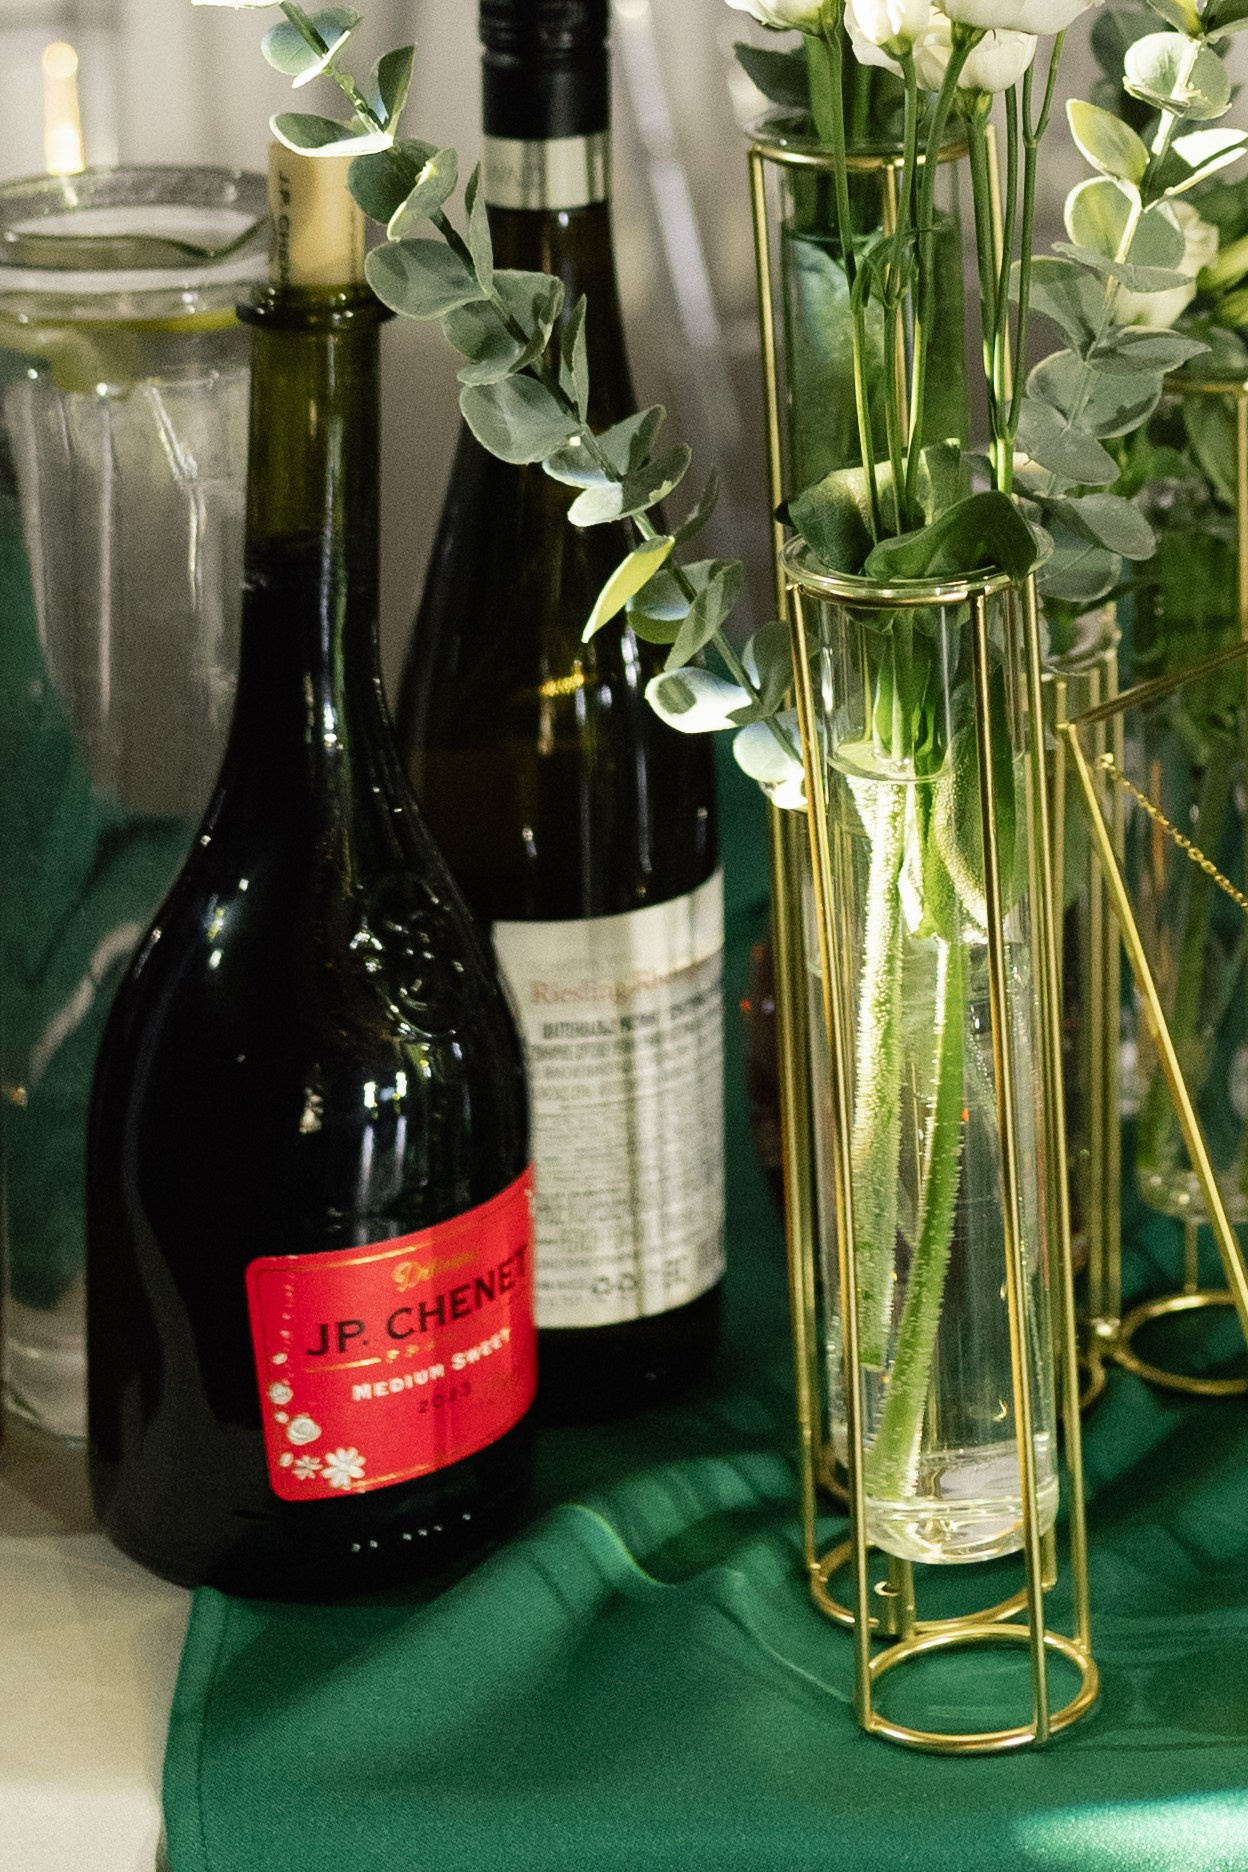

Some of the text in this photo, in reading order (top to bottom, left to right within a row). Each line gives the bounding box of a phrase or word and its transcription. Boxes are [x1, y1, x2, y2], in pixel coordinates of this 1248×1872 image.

[306, 1319, 370, 1356] JP.
[386, 1244, 528, 1340] CHENET
[352, 1328, 511, 1402] MEDIUM SWEET
